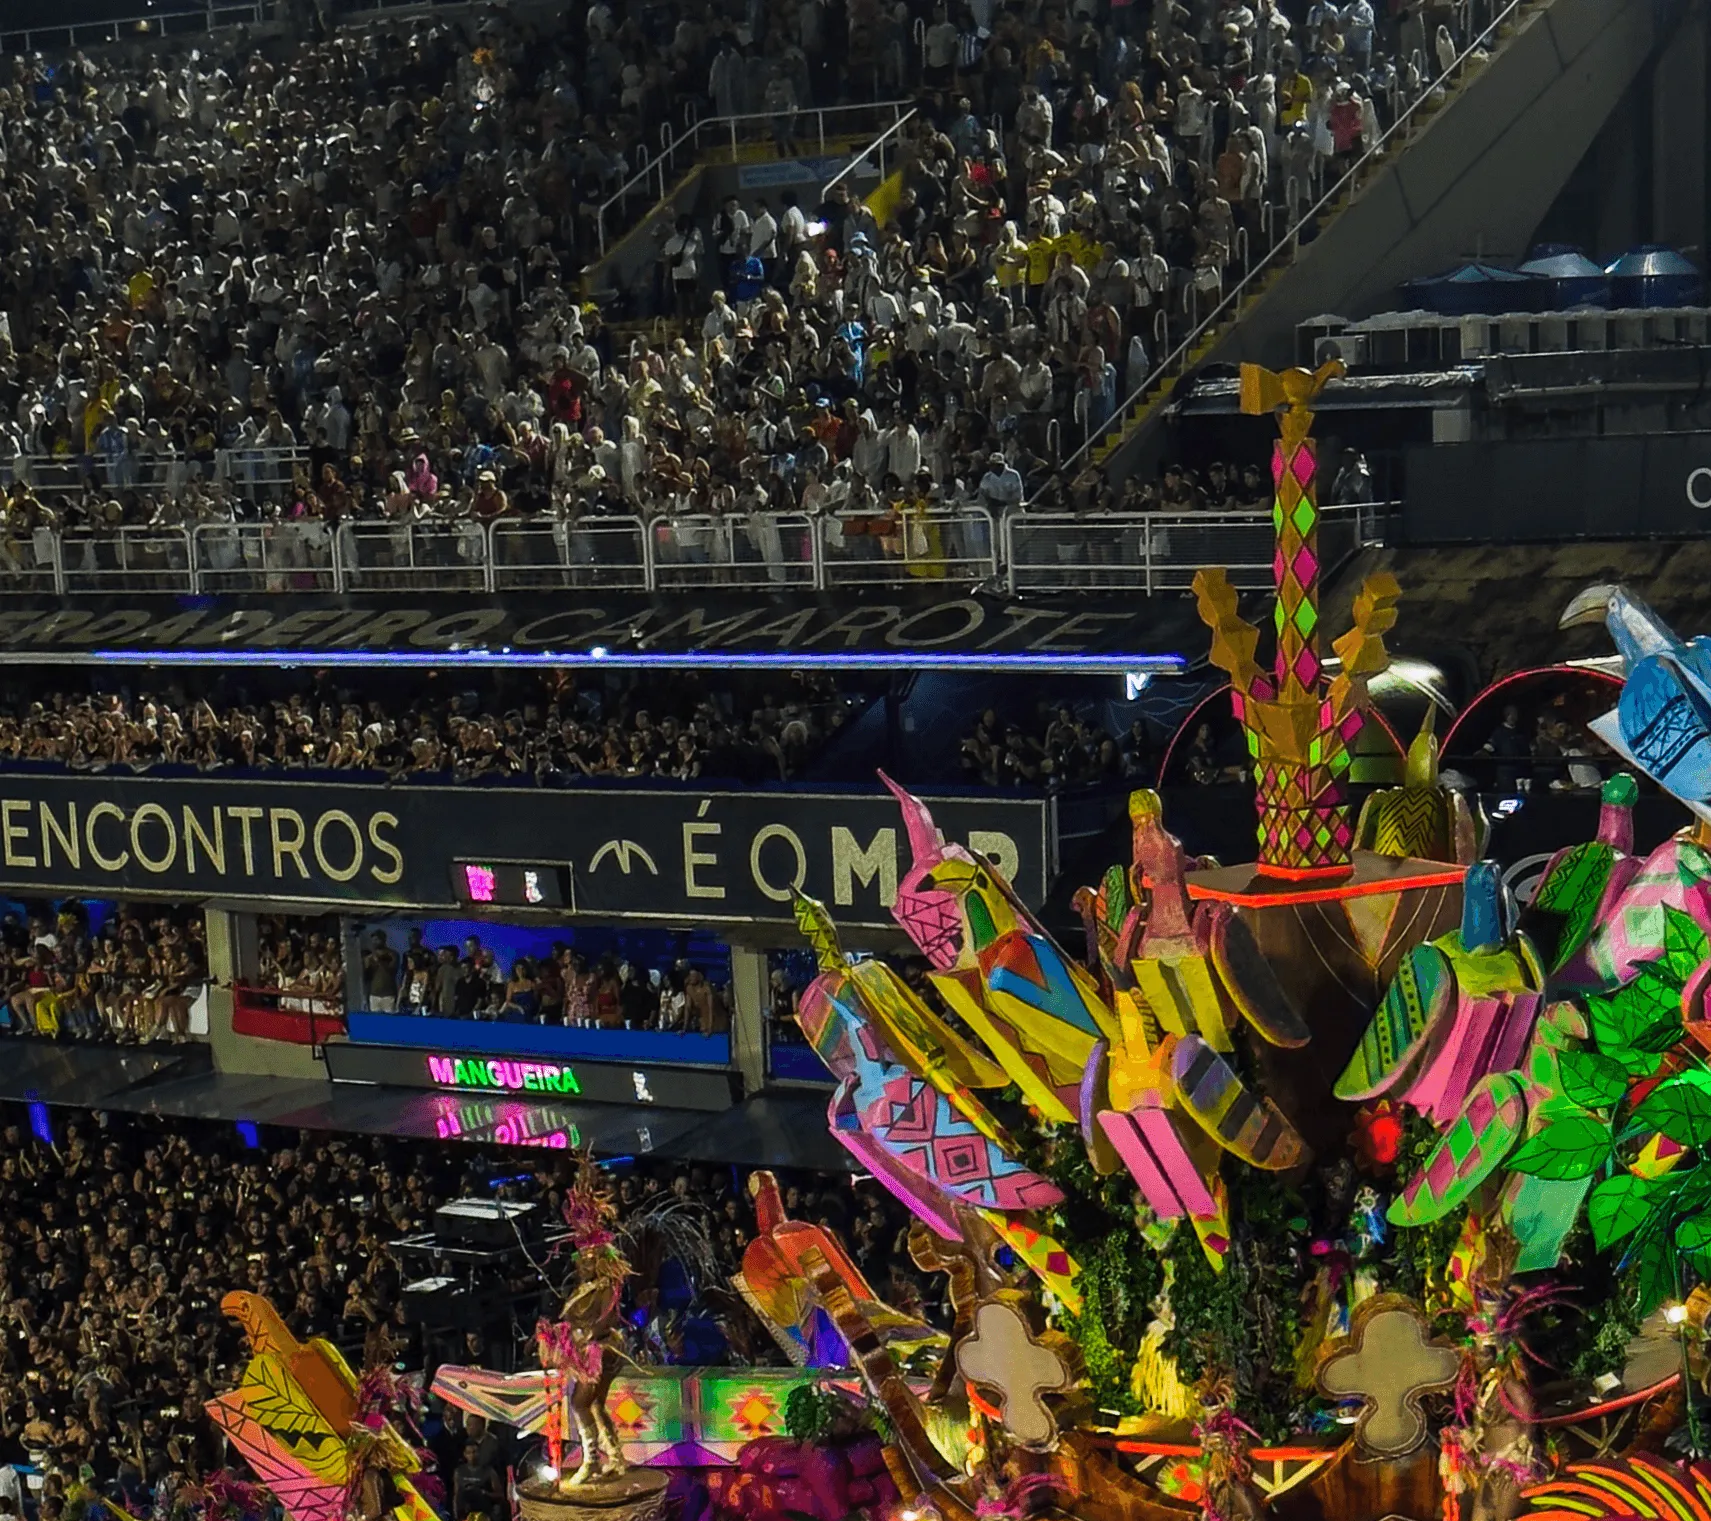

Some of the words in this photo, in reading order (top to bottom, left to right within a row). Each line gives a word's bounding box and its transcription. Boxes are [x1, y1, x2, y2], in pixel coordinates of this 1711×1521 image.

[512, 599, 1138, 651] CAMAROTE
[2, 800, 402, 884] ENCONTROS
[428, 1055, 581, 1094] MANGUEIRA
